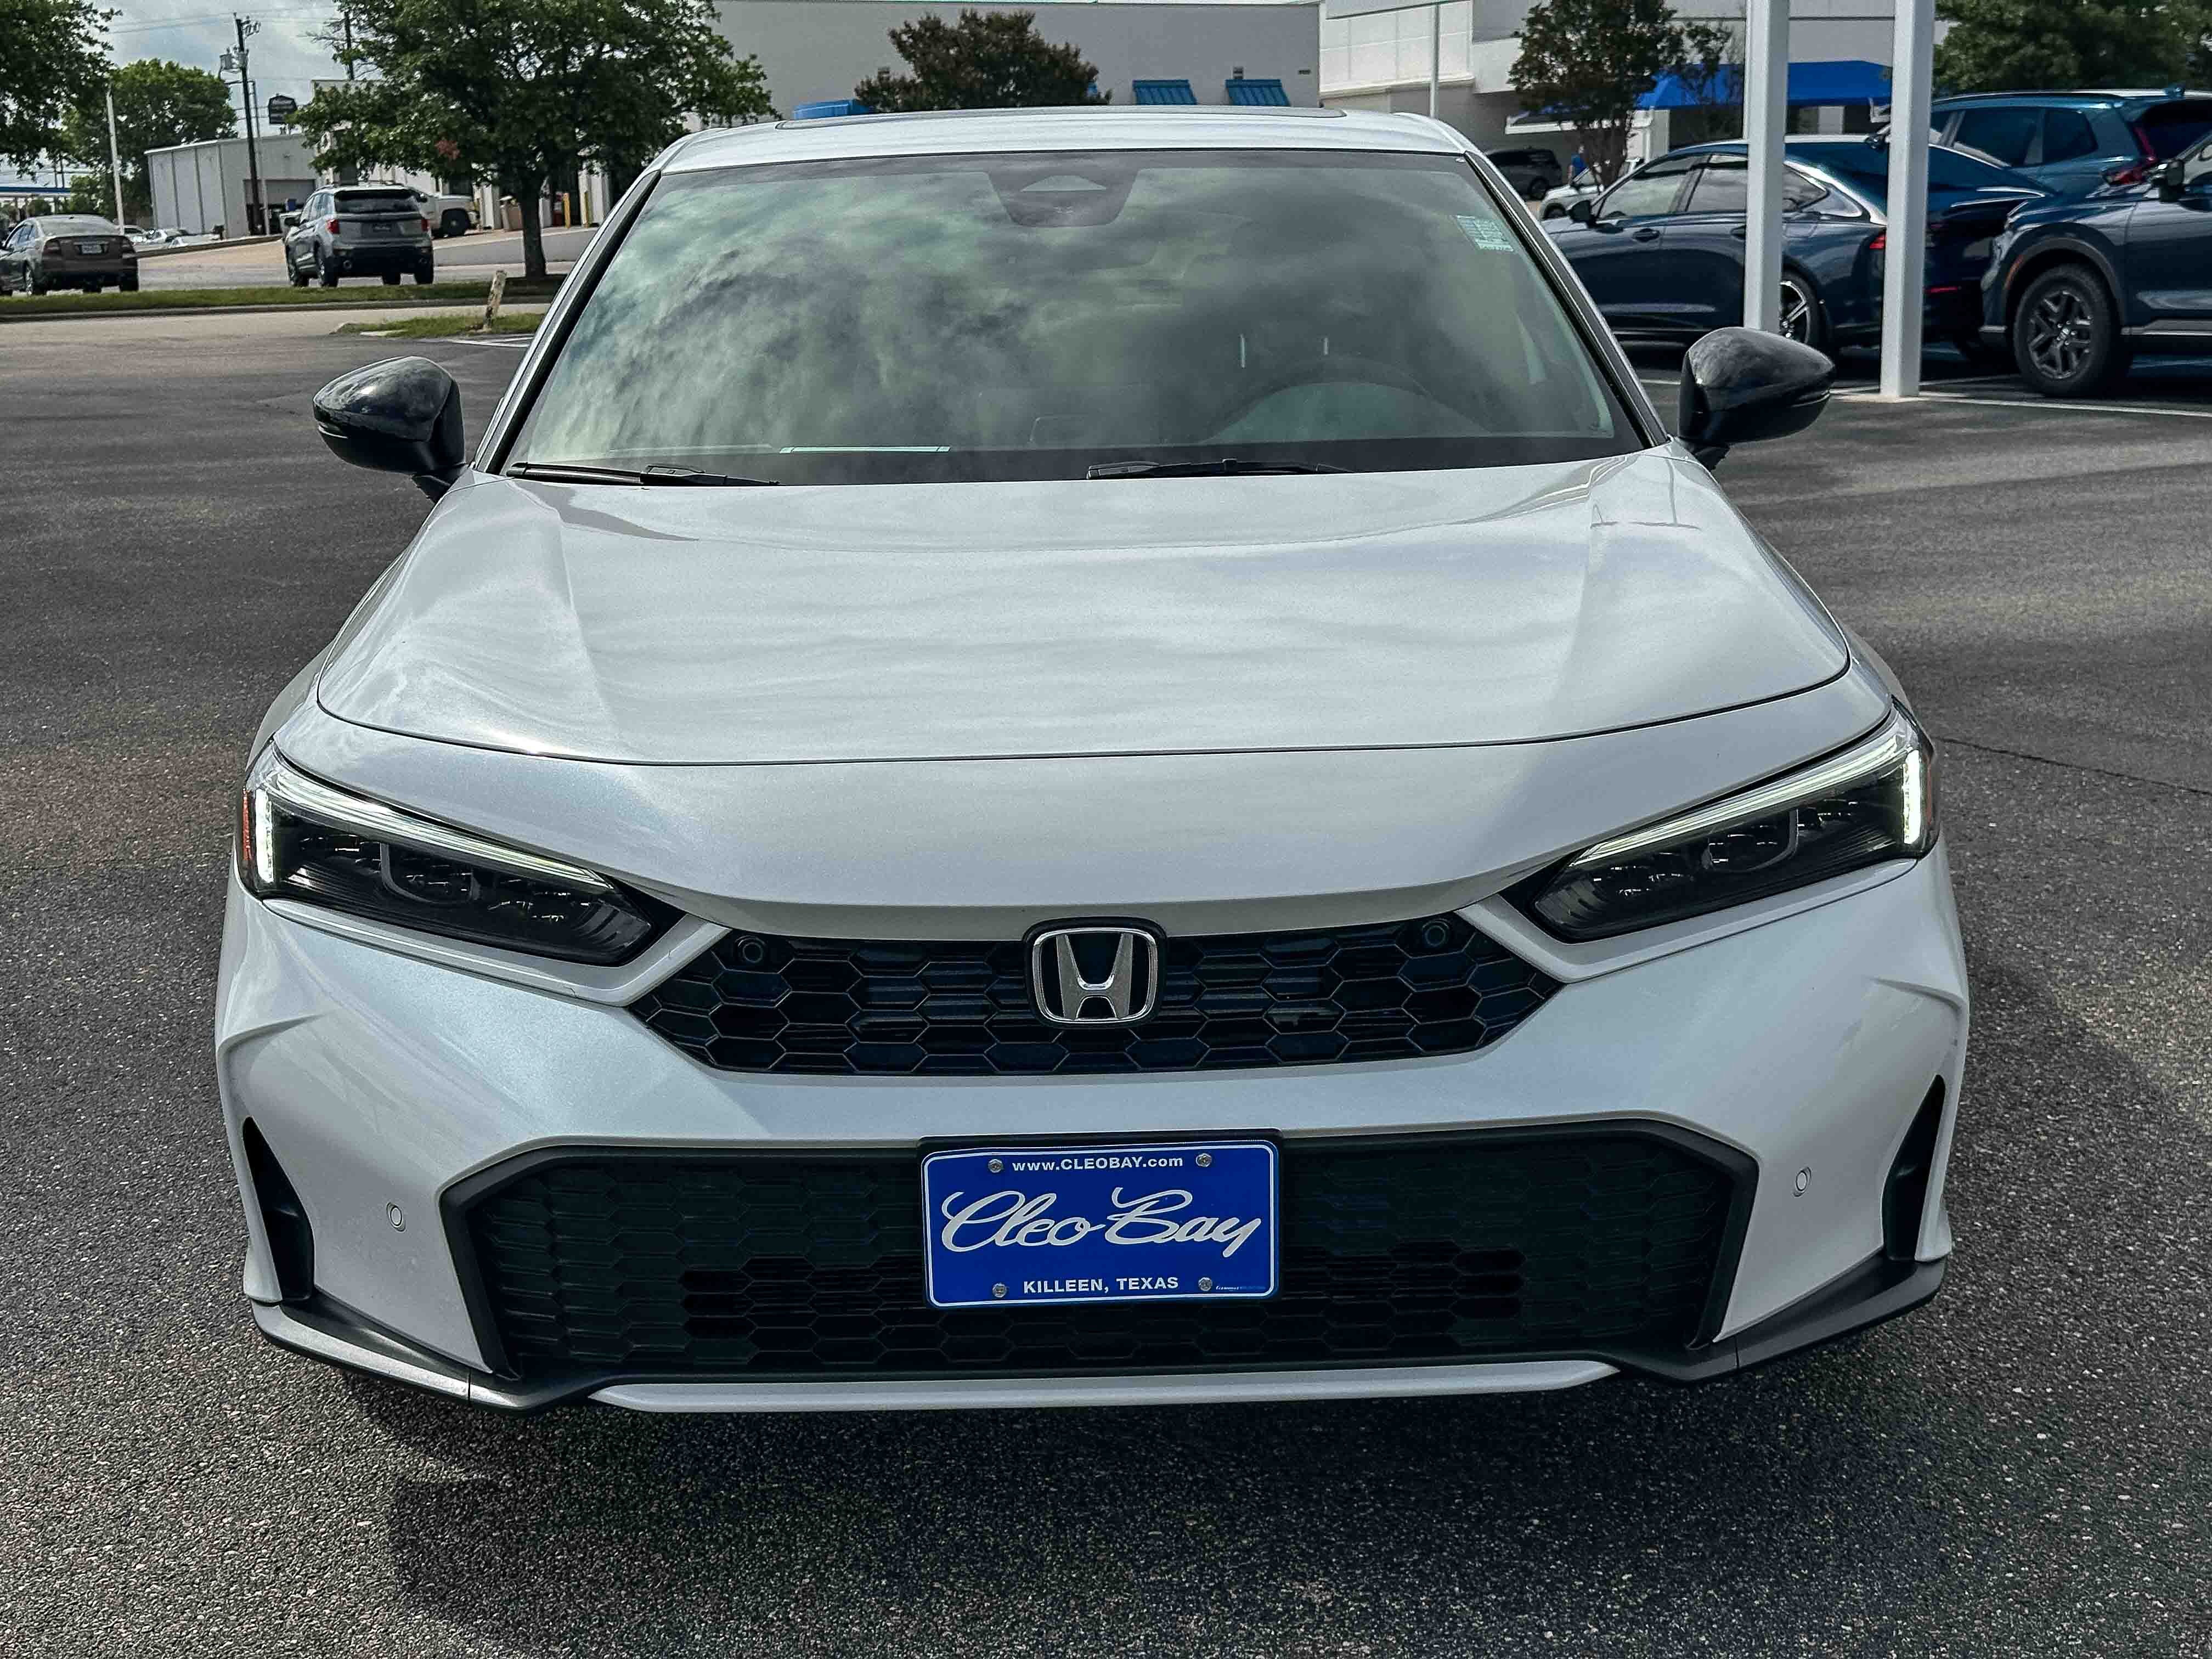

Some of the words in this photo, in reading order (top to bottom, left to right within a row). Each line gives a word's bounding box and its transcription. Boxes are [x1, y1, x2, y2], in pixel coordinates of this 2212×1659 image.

[1012, 1156, 1183, 1171] www.CLEOBAY.com
[941, 1190, 1106, 1252] Cleo
[1104, 1187, 1261, 1257] Bay
[1023, 1279, 1109, 1293] KILLEEN,
[1116, 1277, 1179, 1290] TEXAS
